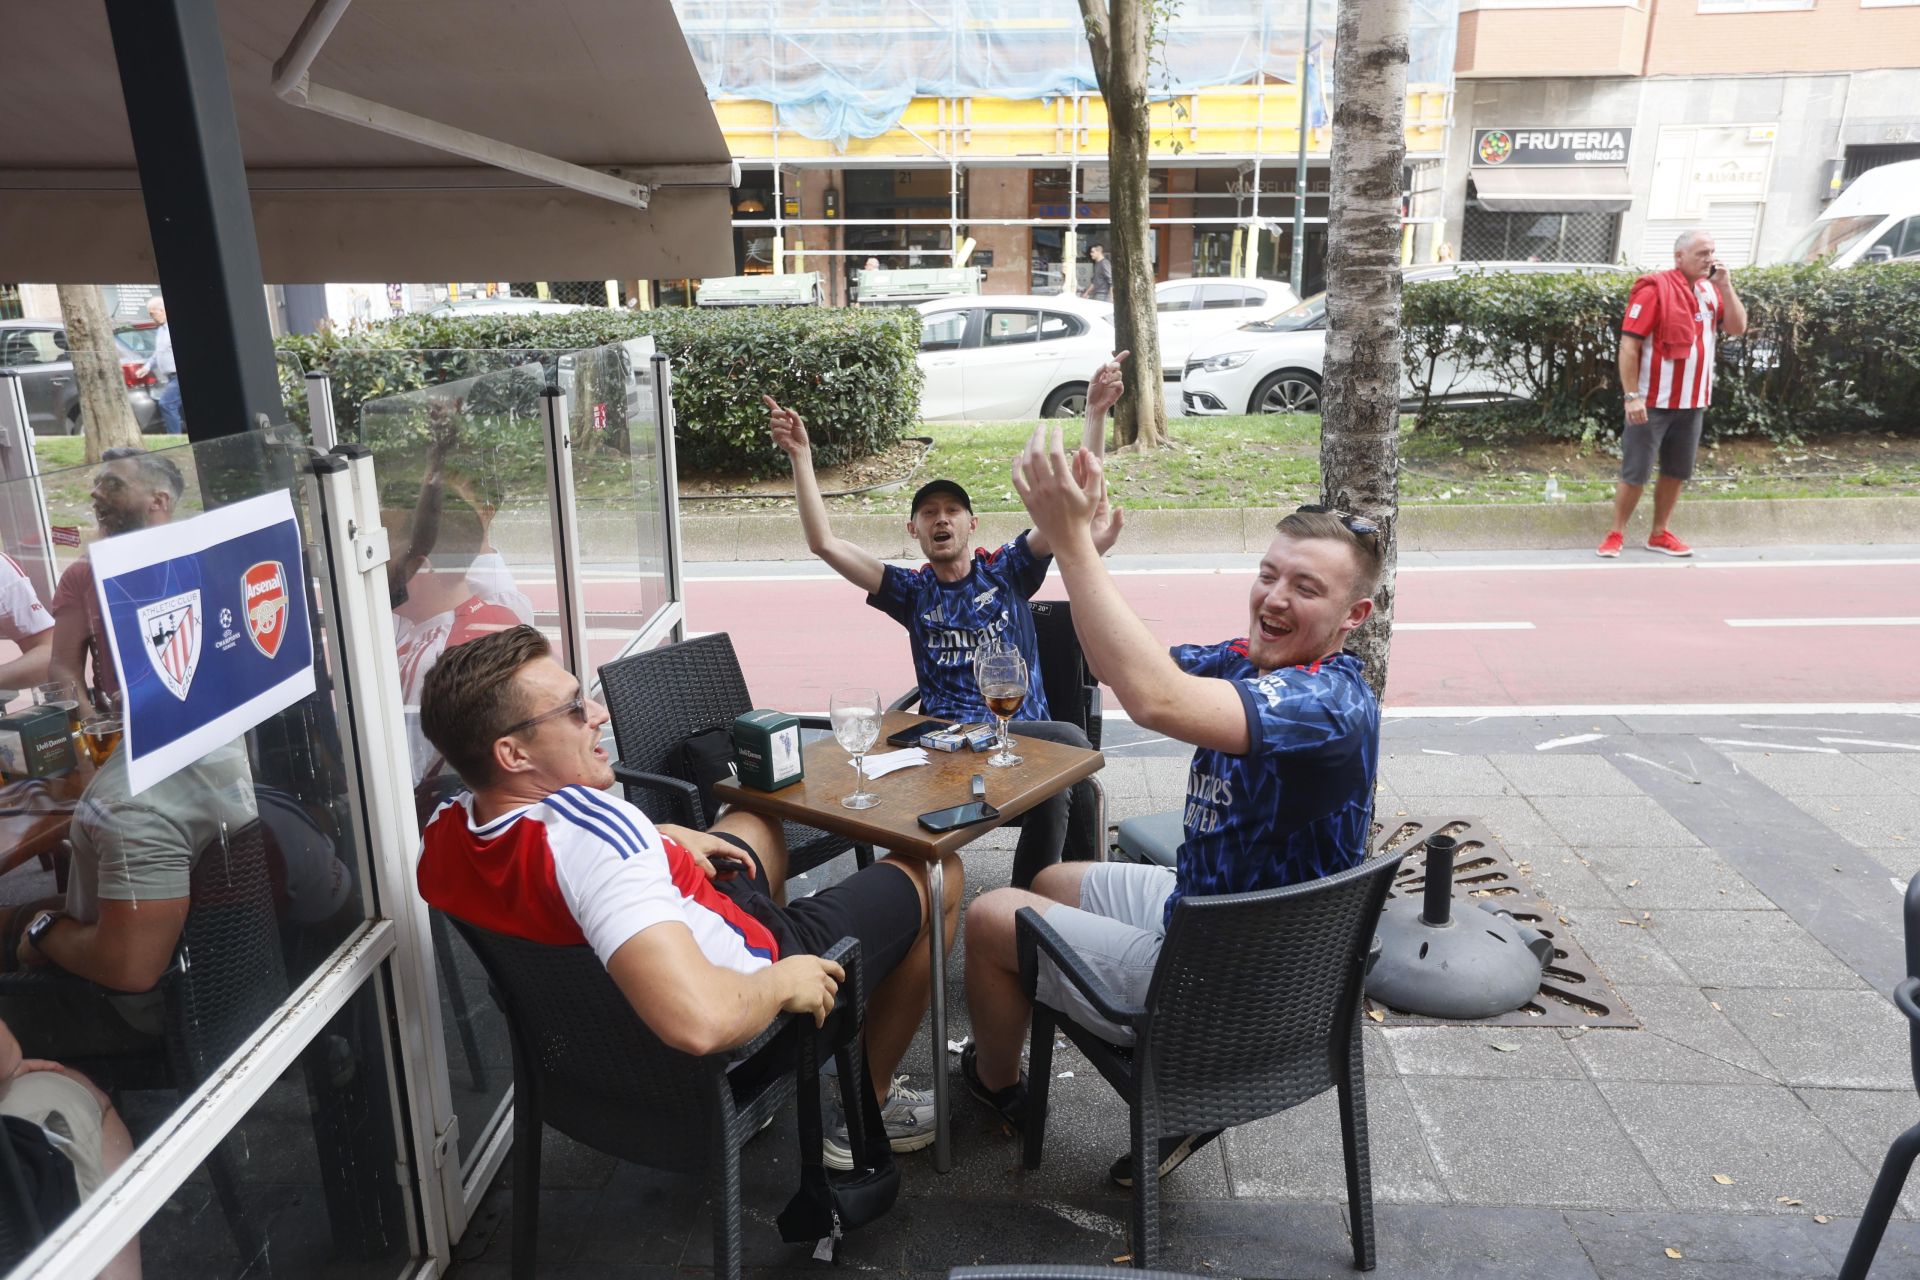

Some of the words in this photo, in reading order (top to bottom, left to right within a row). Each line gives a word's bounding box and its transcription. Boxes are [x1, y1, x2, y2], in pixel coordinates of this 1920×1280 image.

[1515, 131, 1625, 150] FRUTERIA
[247, 573, 281, 600] Arsenal
[142, 600, 175, 617] ATHLETIC
[177, 592, 198, 606] CLUB
[927, 610, 1009, 649] Emirates
